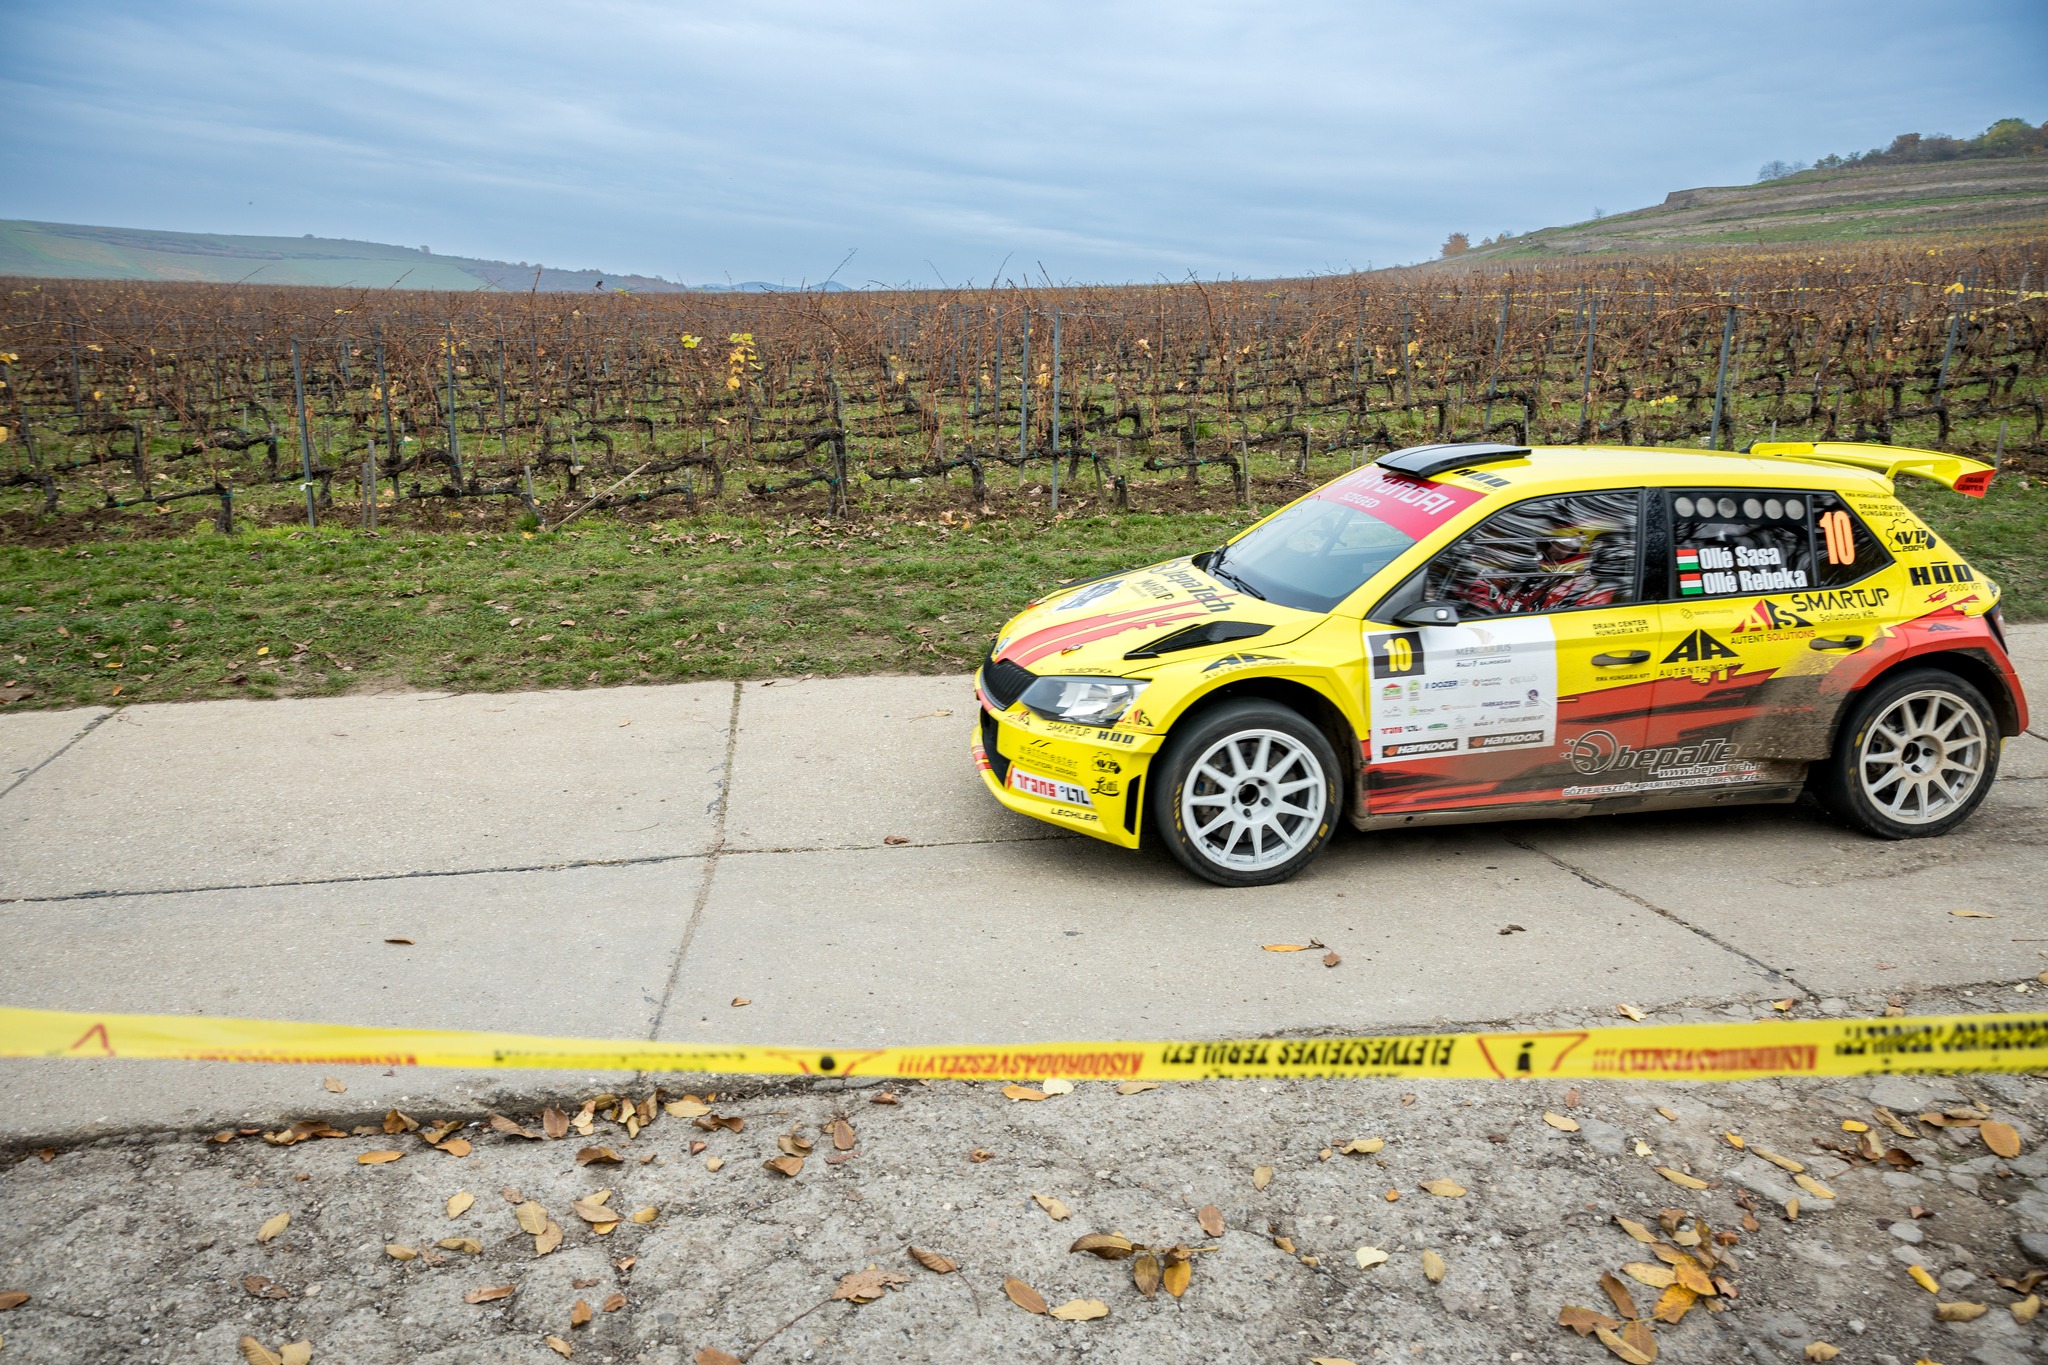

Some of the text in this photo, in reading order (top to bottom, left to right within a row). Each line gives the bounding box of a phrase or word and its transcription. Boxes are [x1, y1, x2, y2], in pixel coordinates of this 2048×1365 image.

[1957, 483, 1984, 492] CENTER
[1341, 492, 1381, 509] SZEGED
[1819, 510, 1856, 566] 10
[1902, 545, 1925, 553] 2004
[1698, 545, 1782, 570] Ollé Sasa
[1702, 567, 1809, 594] Ollé Rebeka
[1948, 584, 1969, 593] 2000
[1791, 588, 1890, 613] SMARTUP
[1819, 610, 1861, 623] Solutions
[1593, 619, 1648, 631] DRAIN CENTER
[1595, 625, 1650, 637] HUNGARIA KFT
[1730, 629, 1817, 647] AUTENT SOLUTIONS
[1382, 637, 1413, 672] 10
[1431, 680, 1458, 689] DOZER
[1050, 807, 1099, 822] LECHLER
